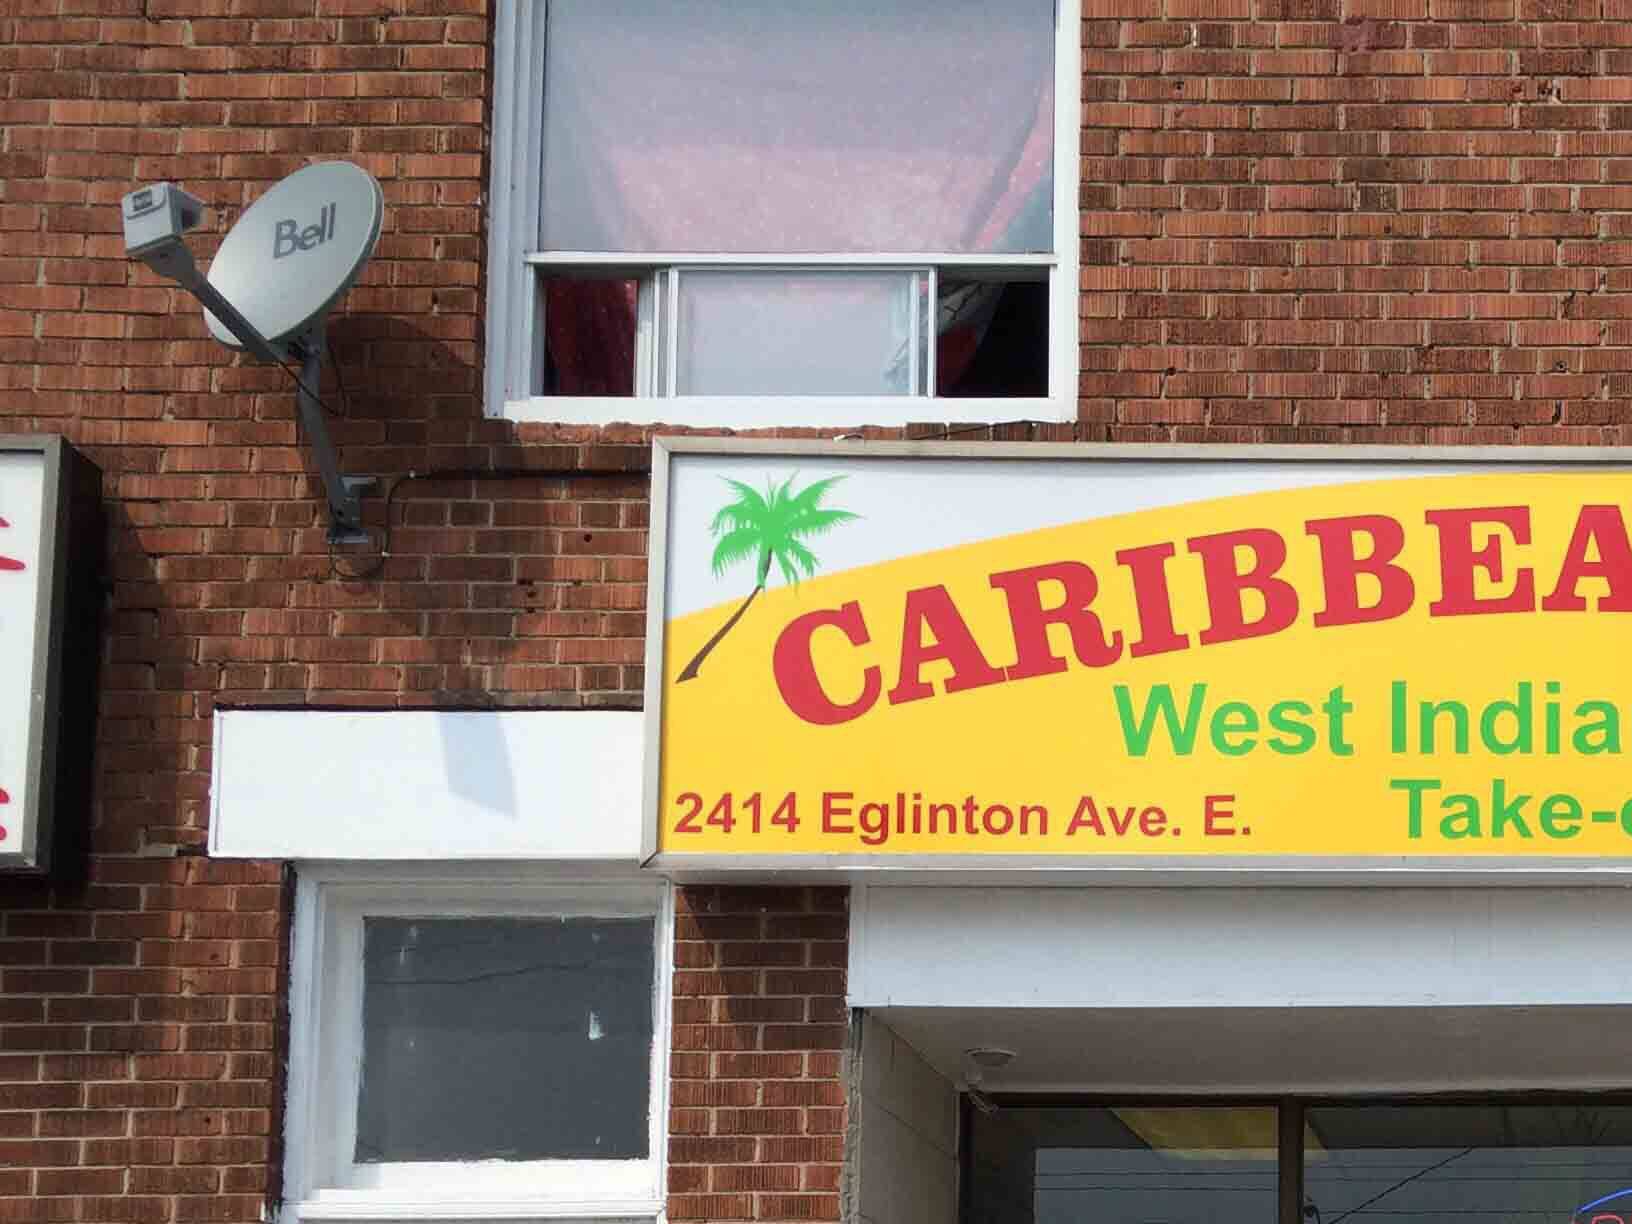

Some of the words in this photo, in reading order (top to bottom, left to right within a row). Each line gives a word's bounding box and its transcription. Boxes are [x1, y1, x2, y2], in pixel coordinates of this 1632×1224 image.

[272, 201, 337, 260] Bell
[1114, 683, 1353, 757] West
[674, 792, 801, 835] 2414
[821, 791, 1049, 846] Eglinton
[1066, 796, 1182, 838] Ave.
[1203, 795, 1252, 837] E.
